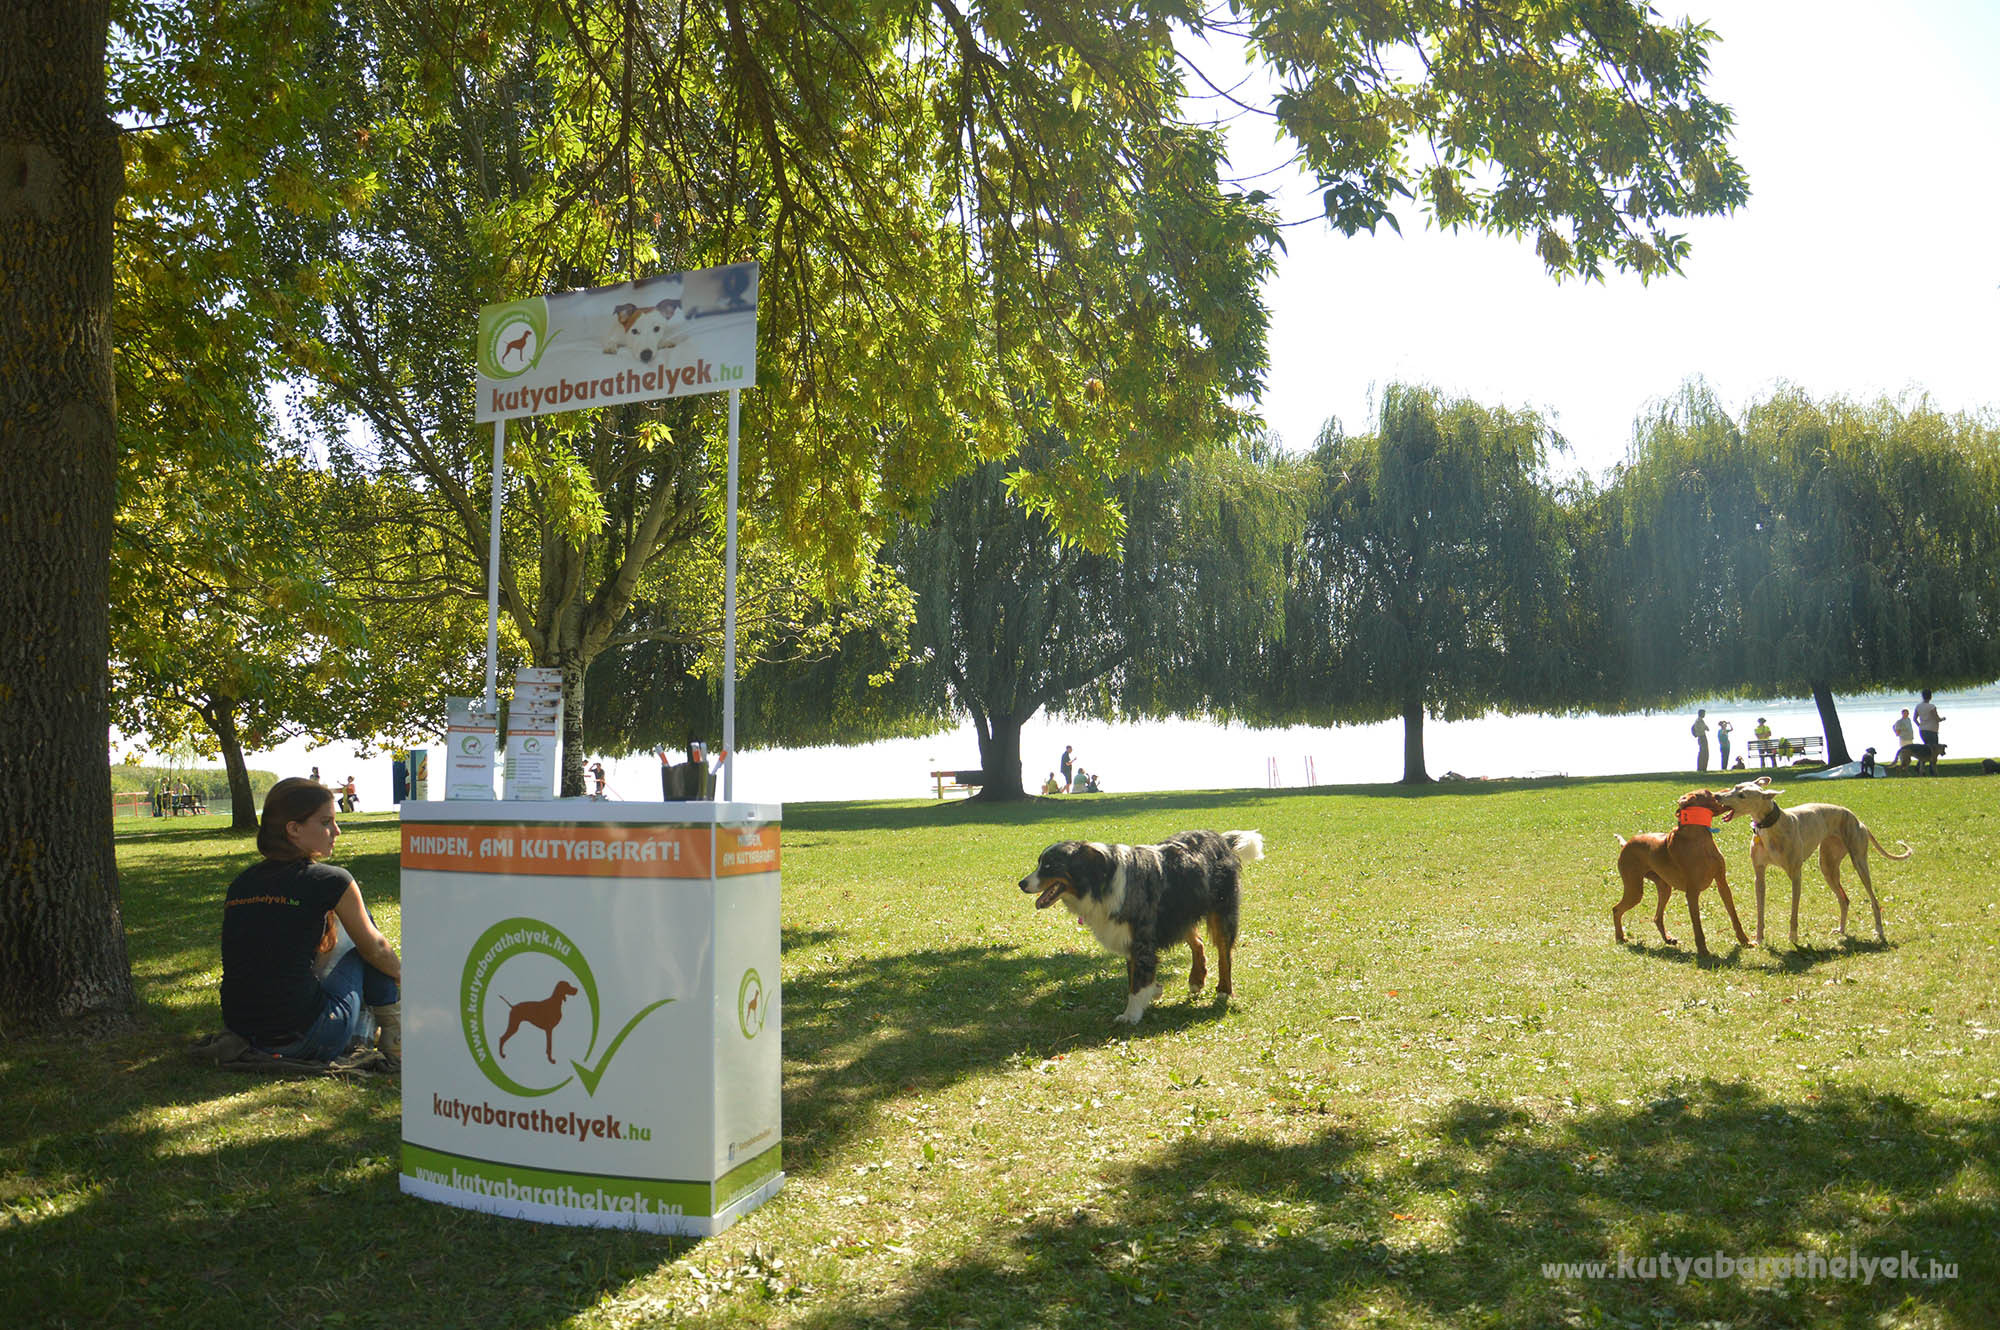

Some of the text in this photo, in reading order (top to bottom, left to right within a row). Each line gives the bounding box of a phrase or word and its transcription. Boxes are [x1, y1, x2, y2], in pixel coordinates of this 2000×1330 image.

[491, 359, 744, 412] kutyabarathelyek.hu
[409, 836, 680, 862] MINDEN, AMI KUTYABARÁT!
[467, 928, 573, 1062] www.kutyabarathelyek.hu
[433, 1092, 652, 1142] kutyabarathelyek.hu
